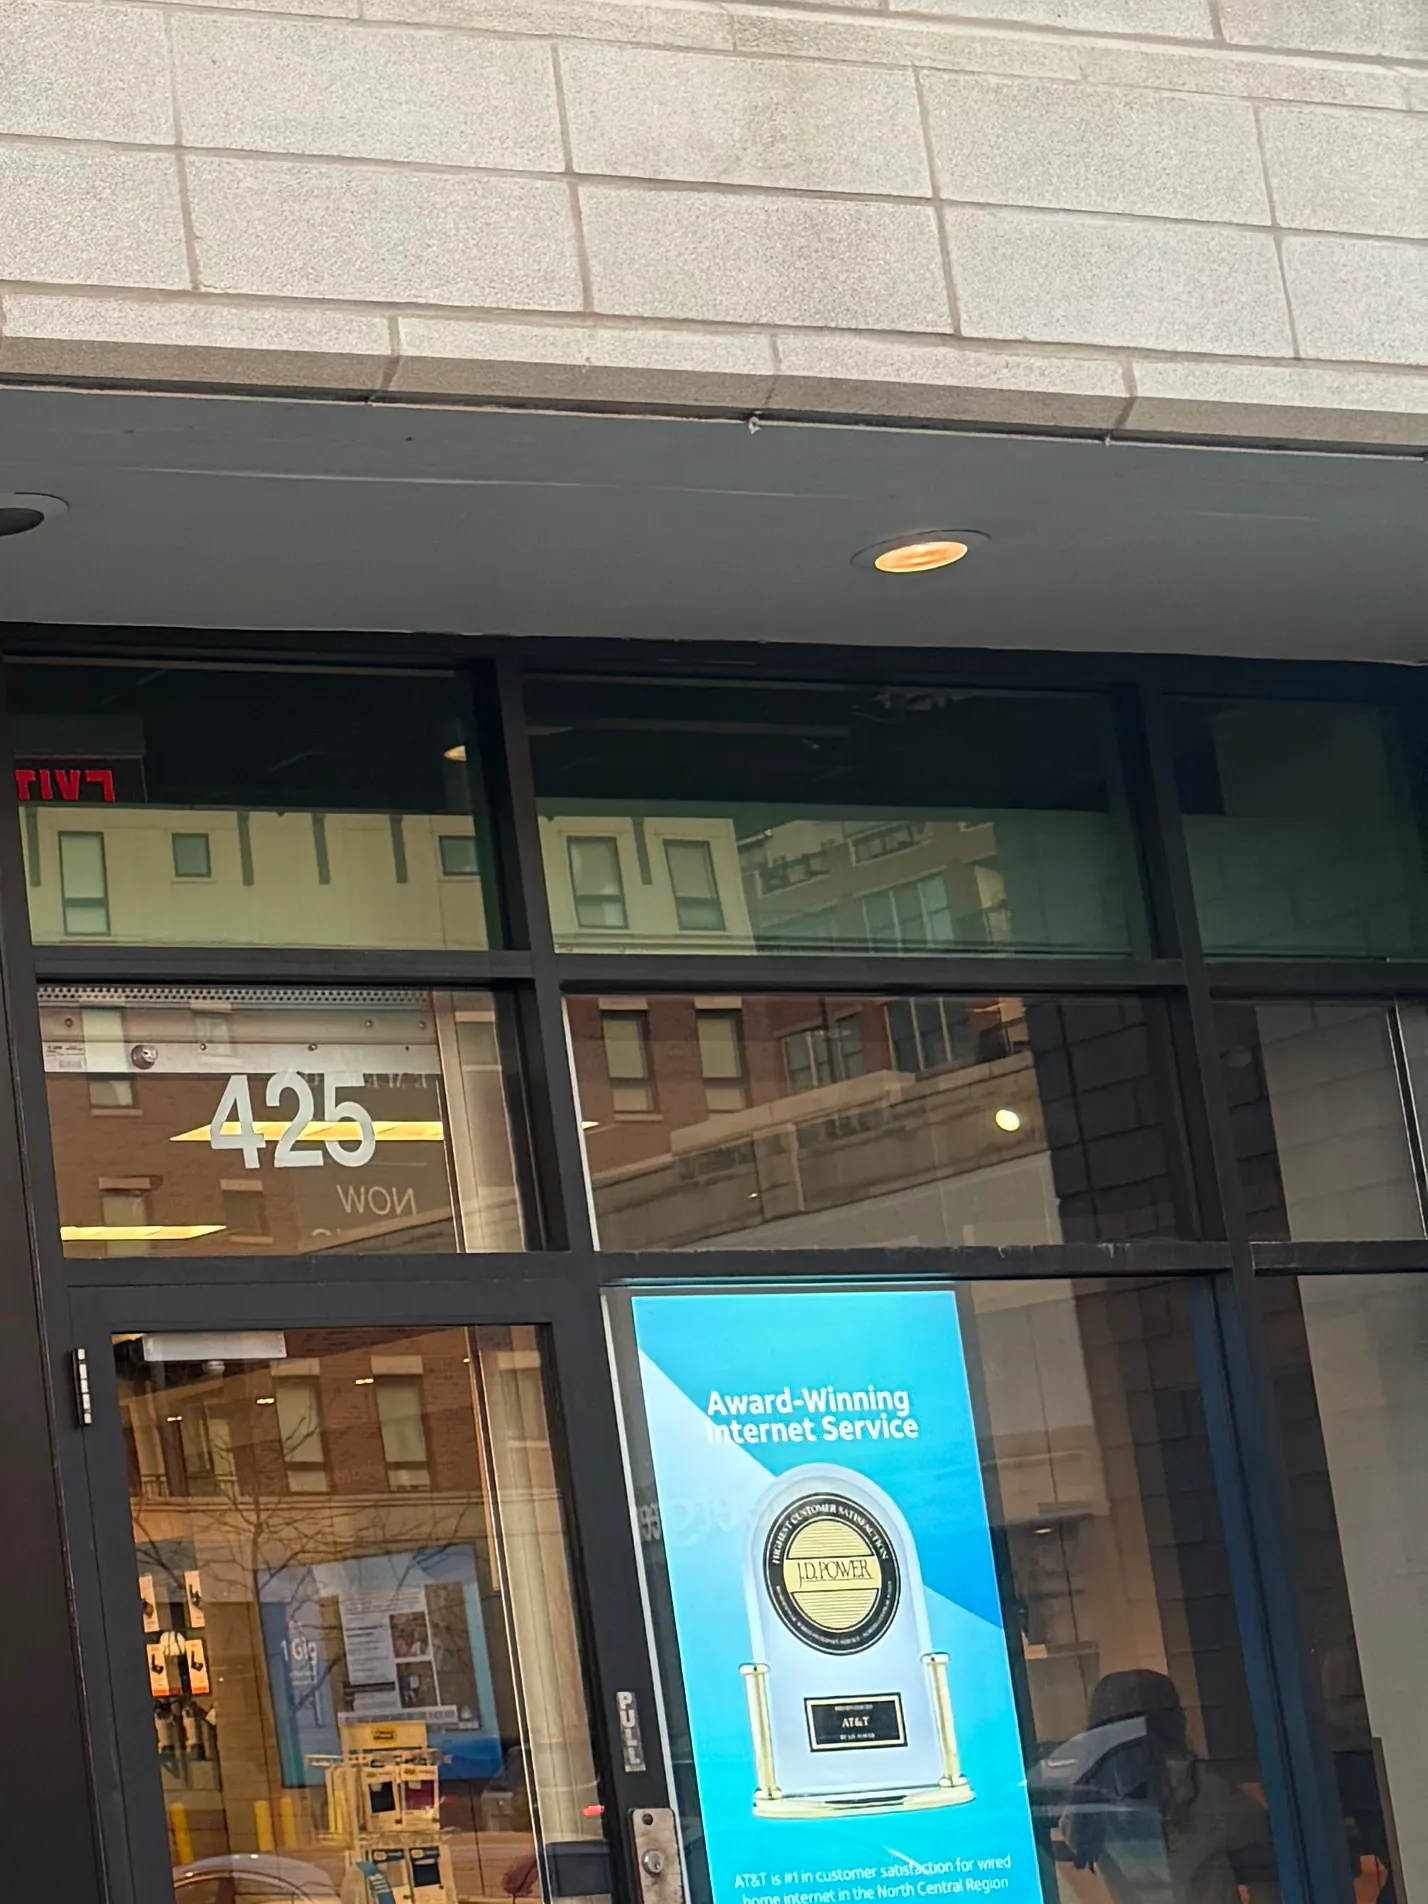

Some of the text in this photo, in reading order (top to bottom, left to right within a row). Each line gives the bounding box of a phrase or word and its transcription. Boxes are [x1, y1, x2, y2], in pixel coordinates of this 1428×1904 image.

[210, 1070, 376, 1169] 425
[707, 1385, 910, 1417] Award-Winning
[705, 1413, 919, 1444] Internet Service
[820, 1559, 873, 1580] POWER
[616, 1691, 641, 1765] PULL
[734, 1872, 766, 1888] AT&T
[816, 1867, 877, 1883] customer
[955, 1857, 973, 1872] for
[977, 1854, 1011, 1870] wired
[838, 1886, 850, 1902] in
[852, 1883, 874, 1900] the
[876, 1880, 915, 1898] North
[917, 1876, 964, 1896] Central
[966, 1876, 1008, 1895] Region
